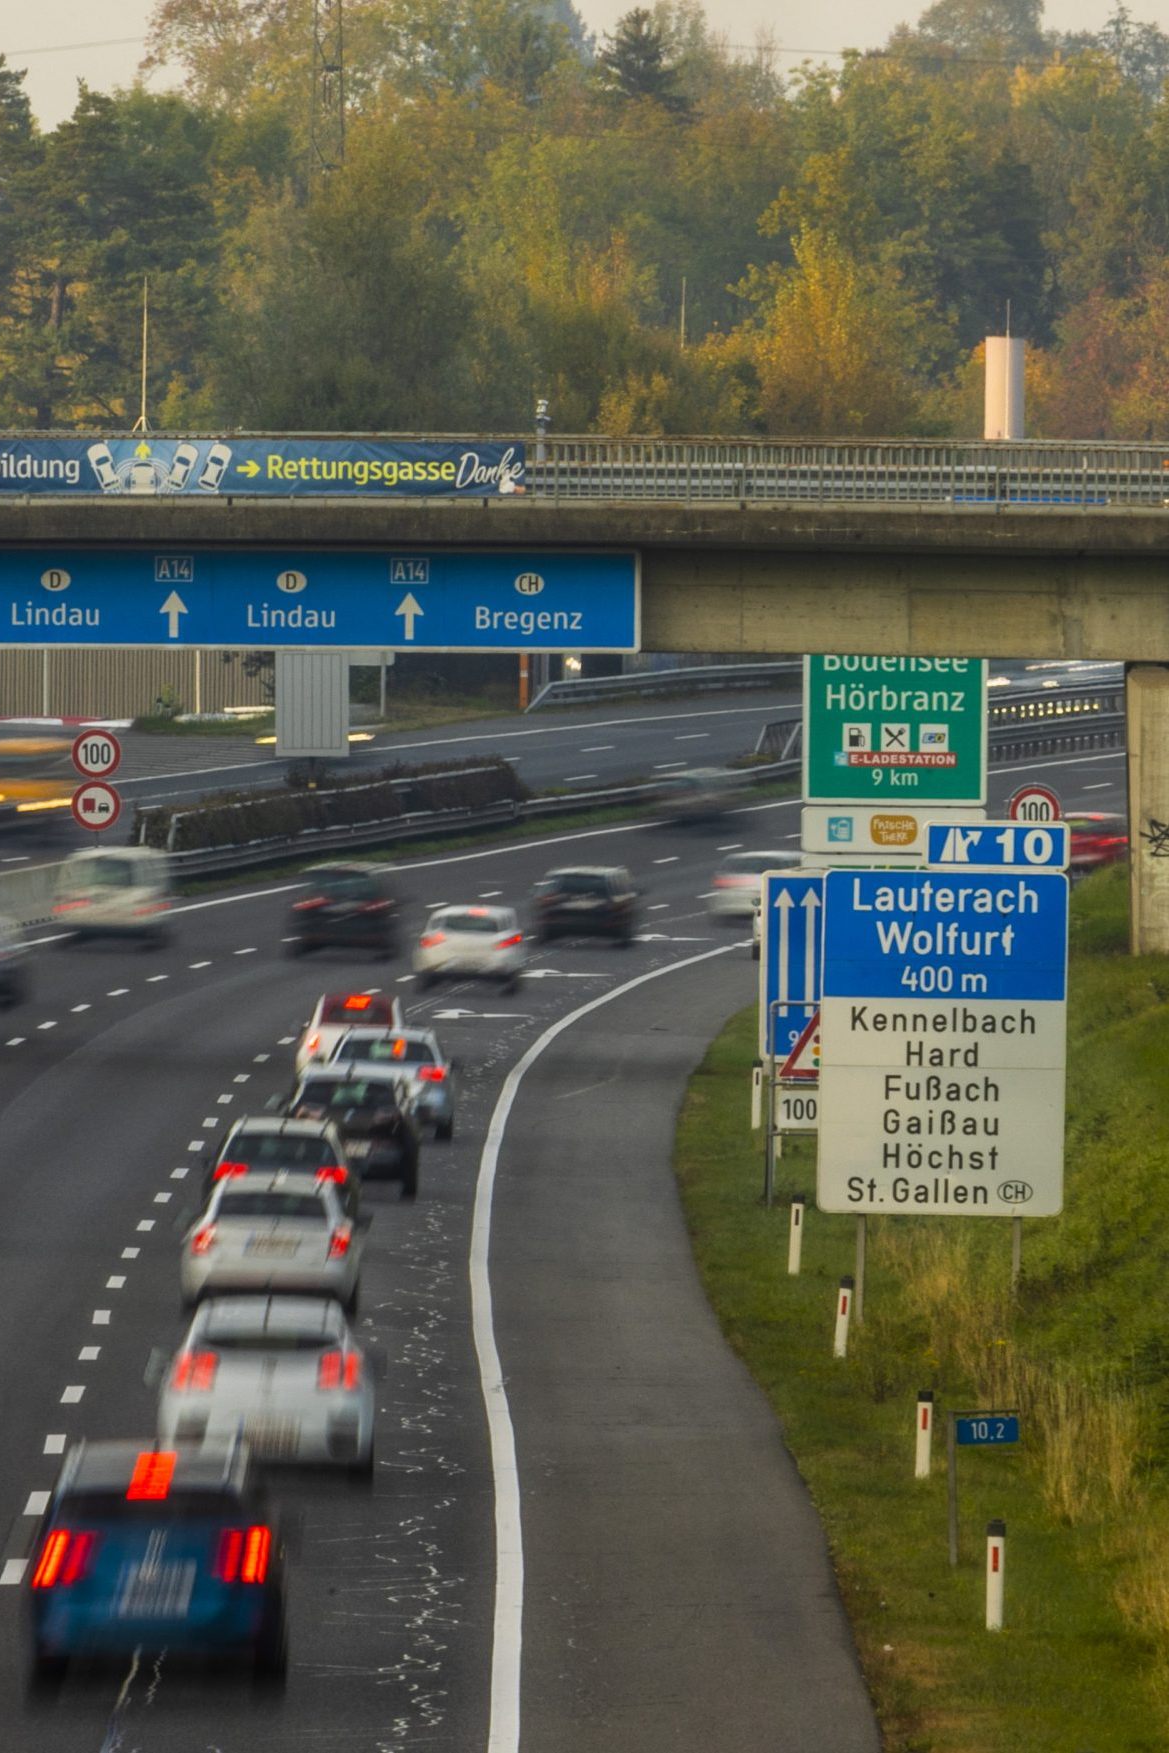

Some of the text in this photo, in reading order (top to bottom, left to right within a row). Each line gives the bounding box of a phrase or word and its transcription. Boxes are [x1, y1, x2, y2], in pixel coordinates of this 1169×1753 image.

[267, 455, 456, 485] Rettungsgasse
[455, 447, 525, 488] Danke
[49, 571, 62, 589] D
[158, 559, 190, 579] A14
[285, 573, 297, 591] D
[394, 561, 426, 581] A14
[518, 576, 540, 593] CH
[11, 602, 100, 626] Lindau
[247, 605, 336, 628] Lindau
[475, 606, 583, 635] Bregenz
[826, 683, 965, 712] Hörbranz
[82, 743, 111, 765] 100
[850, 754, 956, 765] E-LADESTATION
[872, 769, 919, 786] 9 km
[1021, 801, 1050, 821] 100
[996, 828, 1053, 864] 10
[853, 878, 1038, 914] Lauterach
[876, 921, 1015, 956] Wolfurt
[901, 966, 987, 992] 400 m
[851, 1006, 1036, 1034] Kennelbach
[906, 1041, 979, 1067] Hard
[884, 1075, 999, 1102] Fußach
[883, 1109, 999, 1136] Gaißau
[883, 1143, 999, 1170] Höchst
[847, 1177, 1026, 1204] St. Gallen CH
[971, 1421, 1005, 1440] 10.2
